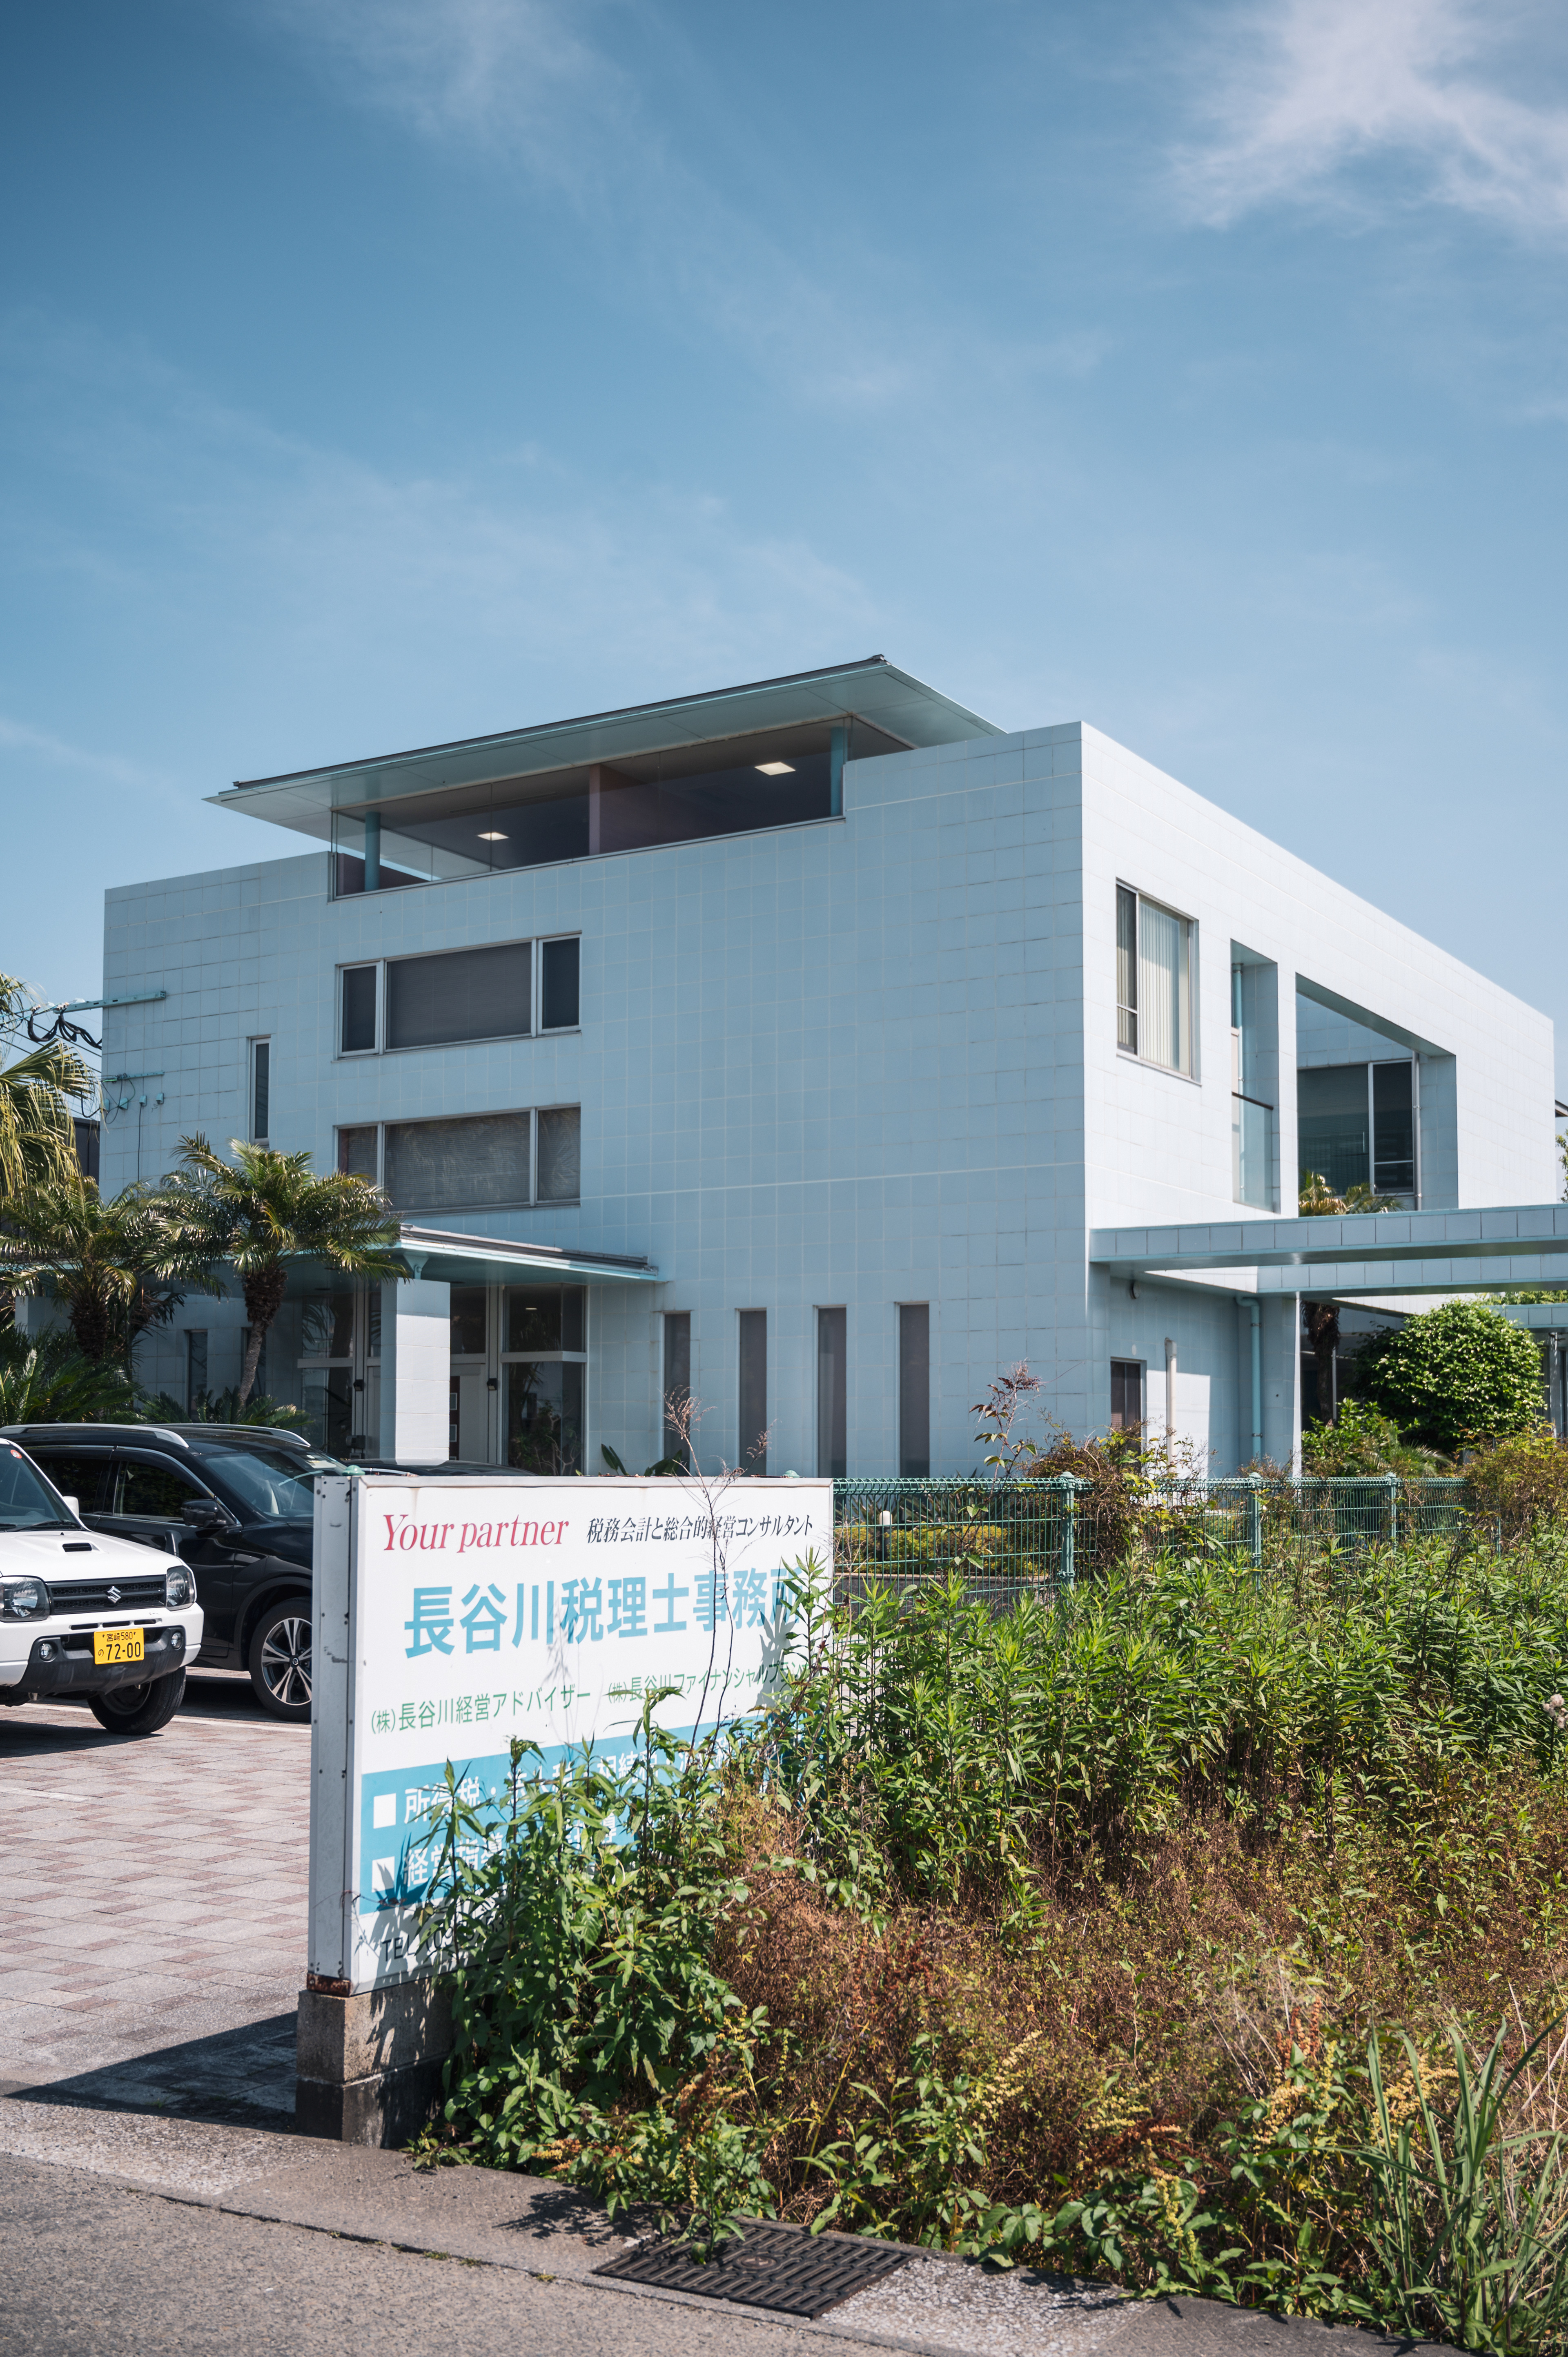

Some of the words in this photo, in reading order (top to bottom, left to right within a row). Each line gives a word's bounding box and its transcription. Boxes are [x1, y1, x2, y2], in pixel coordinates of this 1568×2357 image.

[383, 1514, 454, 1551] Your
[456, 1514, 569, 1553] partner
[586, 1514, 813, 1544] 税務会計と総合的経営コンサルタント
[404, 1566, 803, 1659] 長谷川税理士事務所
[106, 1641, 140, 1661] 72-00
[382, 1934, 415, 1962] TEL
